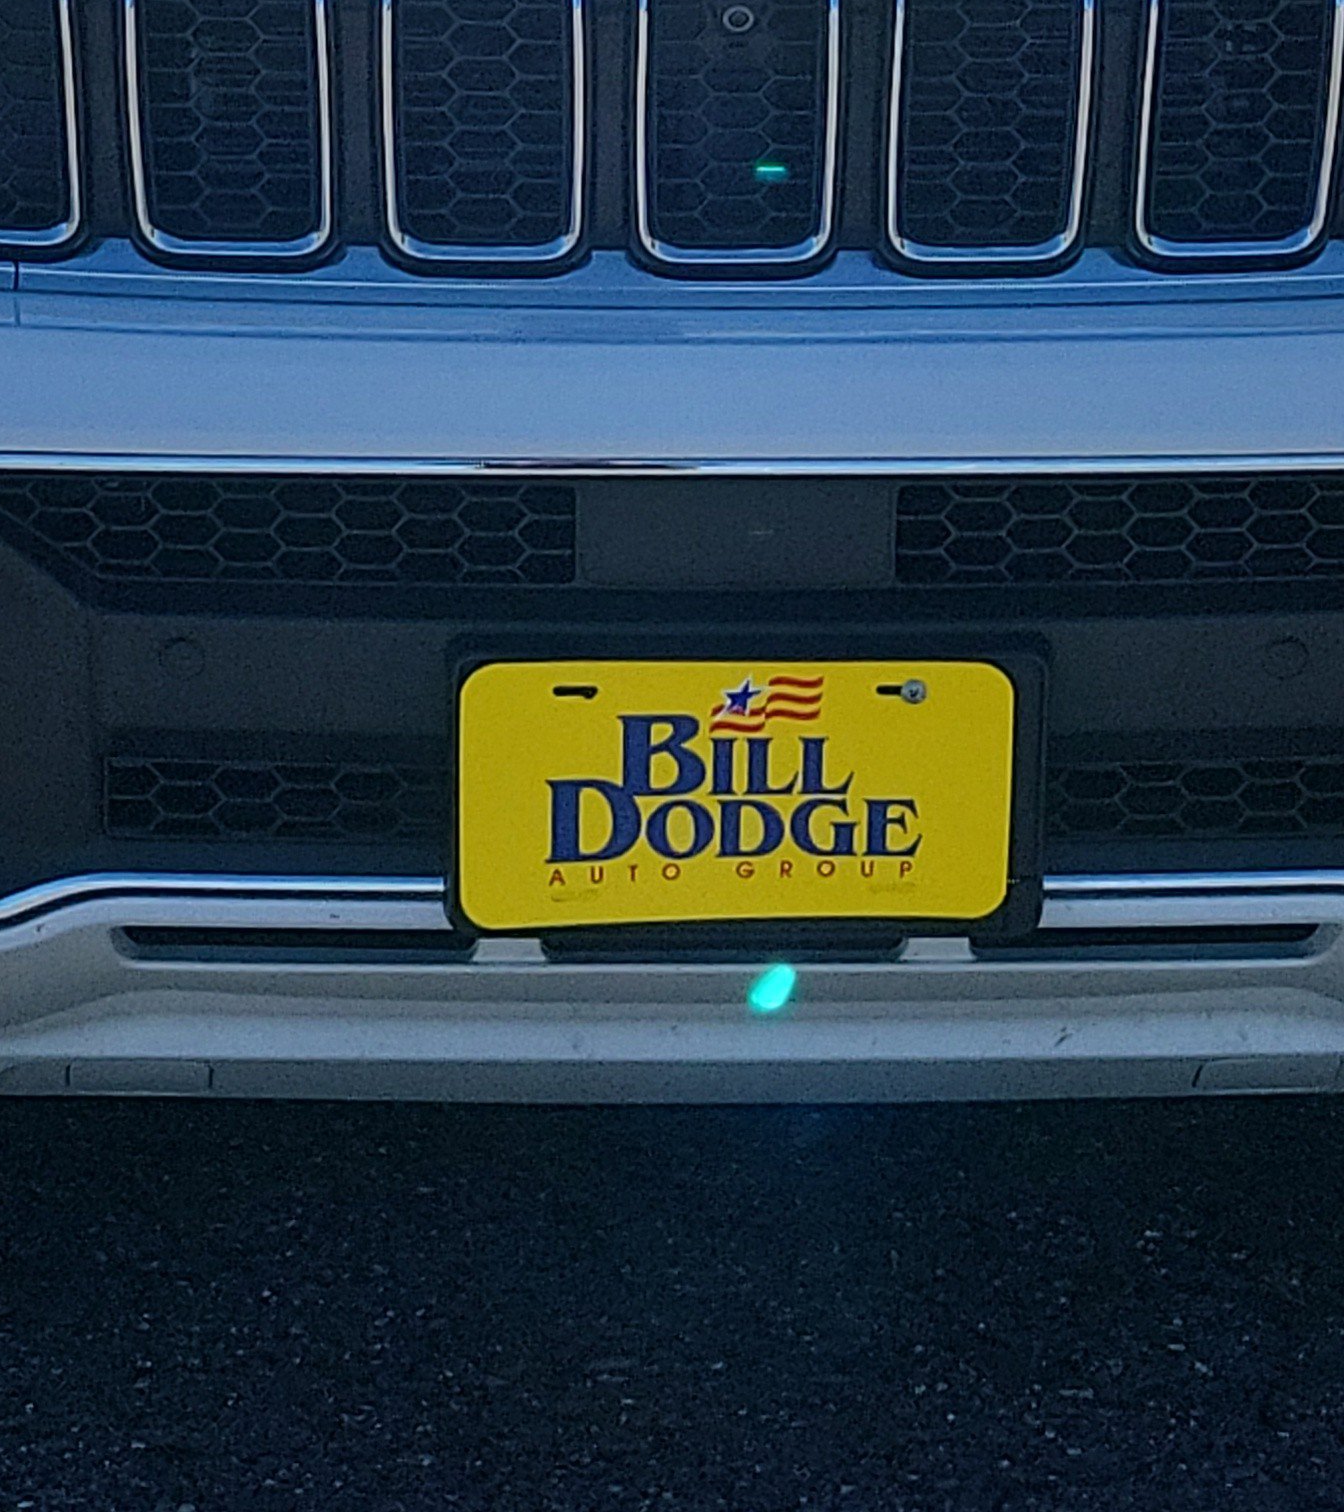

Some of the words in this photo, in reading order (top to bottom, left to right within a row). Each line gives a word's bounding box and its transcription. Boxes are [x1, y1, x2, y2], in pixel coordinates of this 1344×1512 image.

[617, 713, 855, 797] BILL
[544, 778, 924, 864] DODGE
[547, 863, 682, 887] AUTO
[735, 859, 916, 880] GROUP
